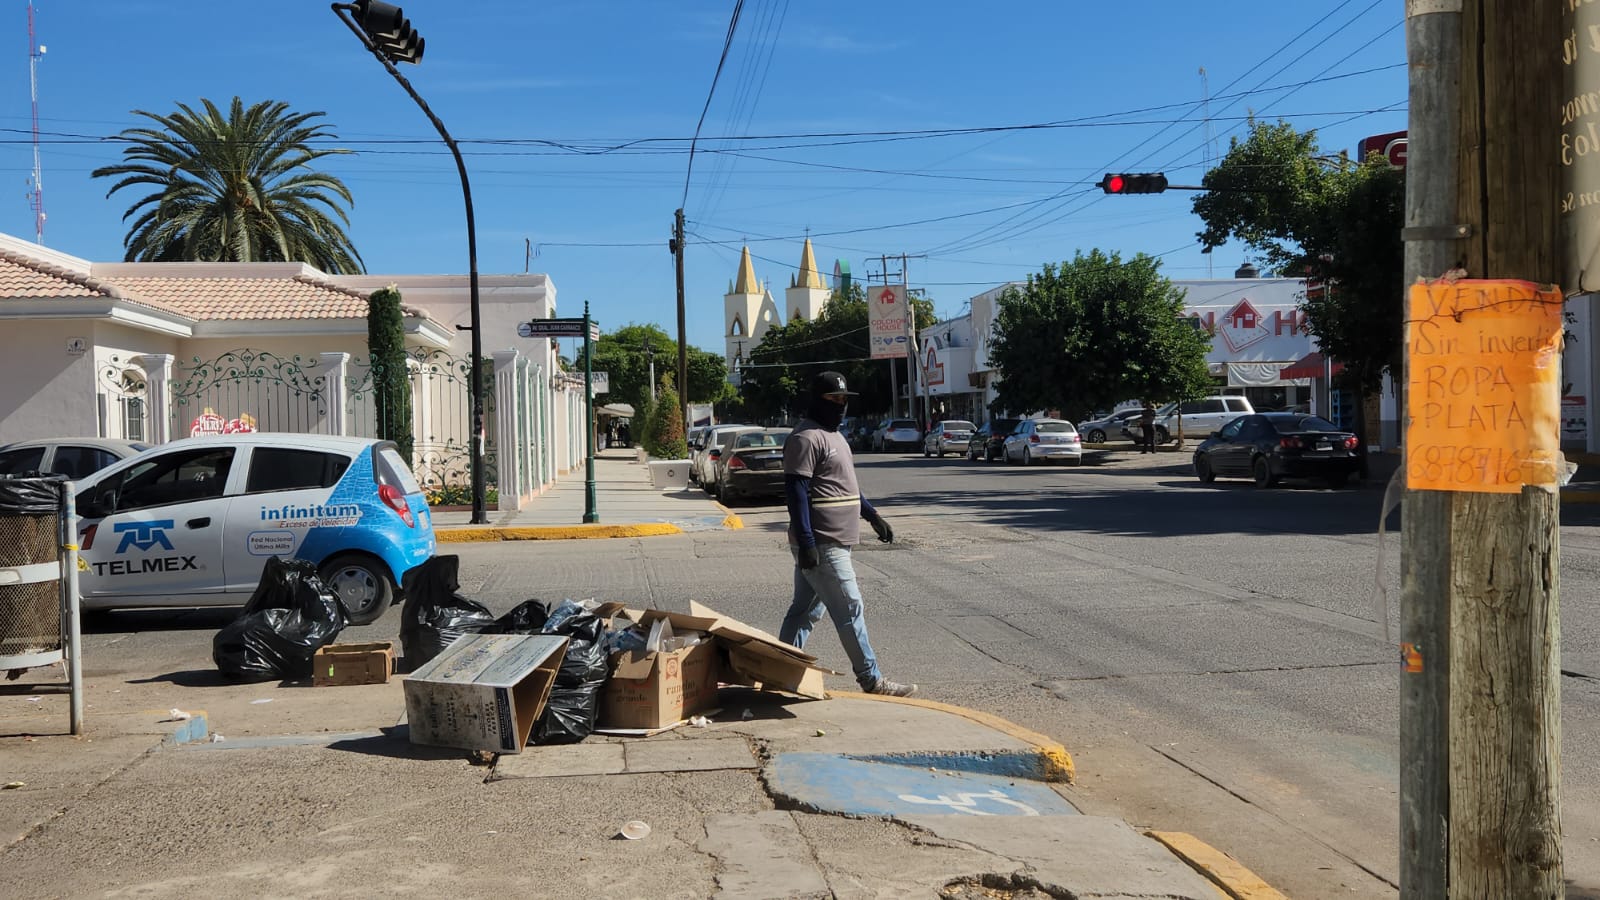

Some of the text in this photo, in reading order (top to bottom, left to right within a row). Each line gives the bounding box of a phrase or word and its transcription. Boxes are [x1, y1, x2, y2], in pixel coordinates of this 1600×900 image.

[261, 504, 358, 520] infinitum
[280, 520, 308, 528] Exceso
[308, 519, 319, 527] de
[92, 555, 199, 576] TELMEX
